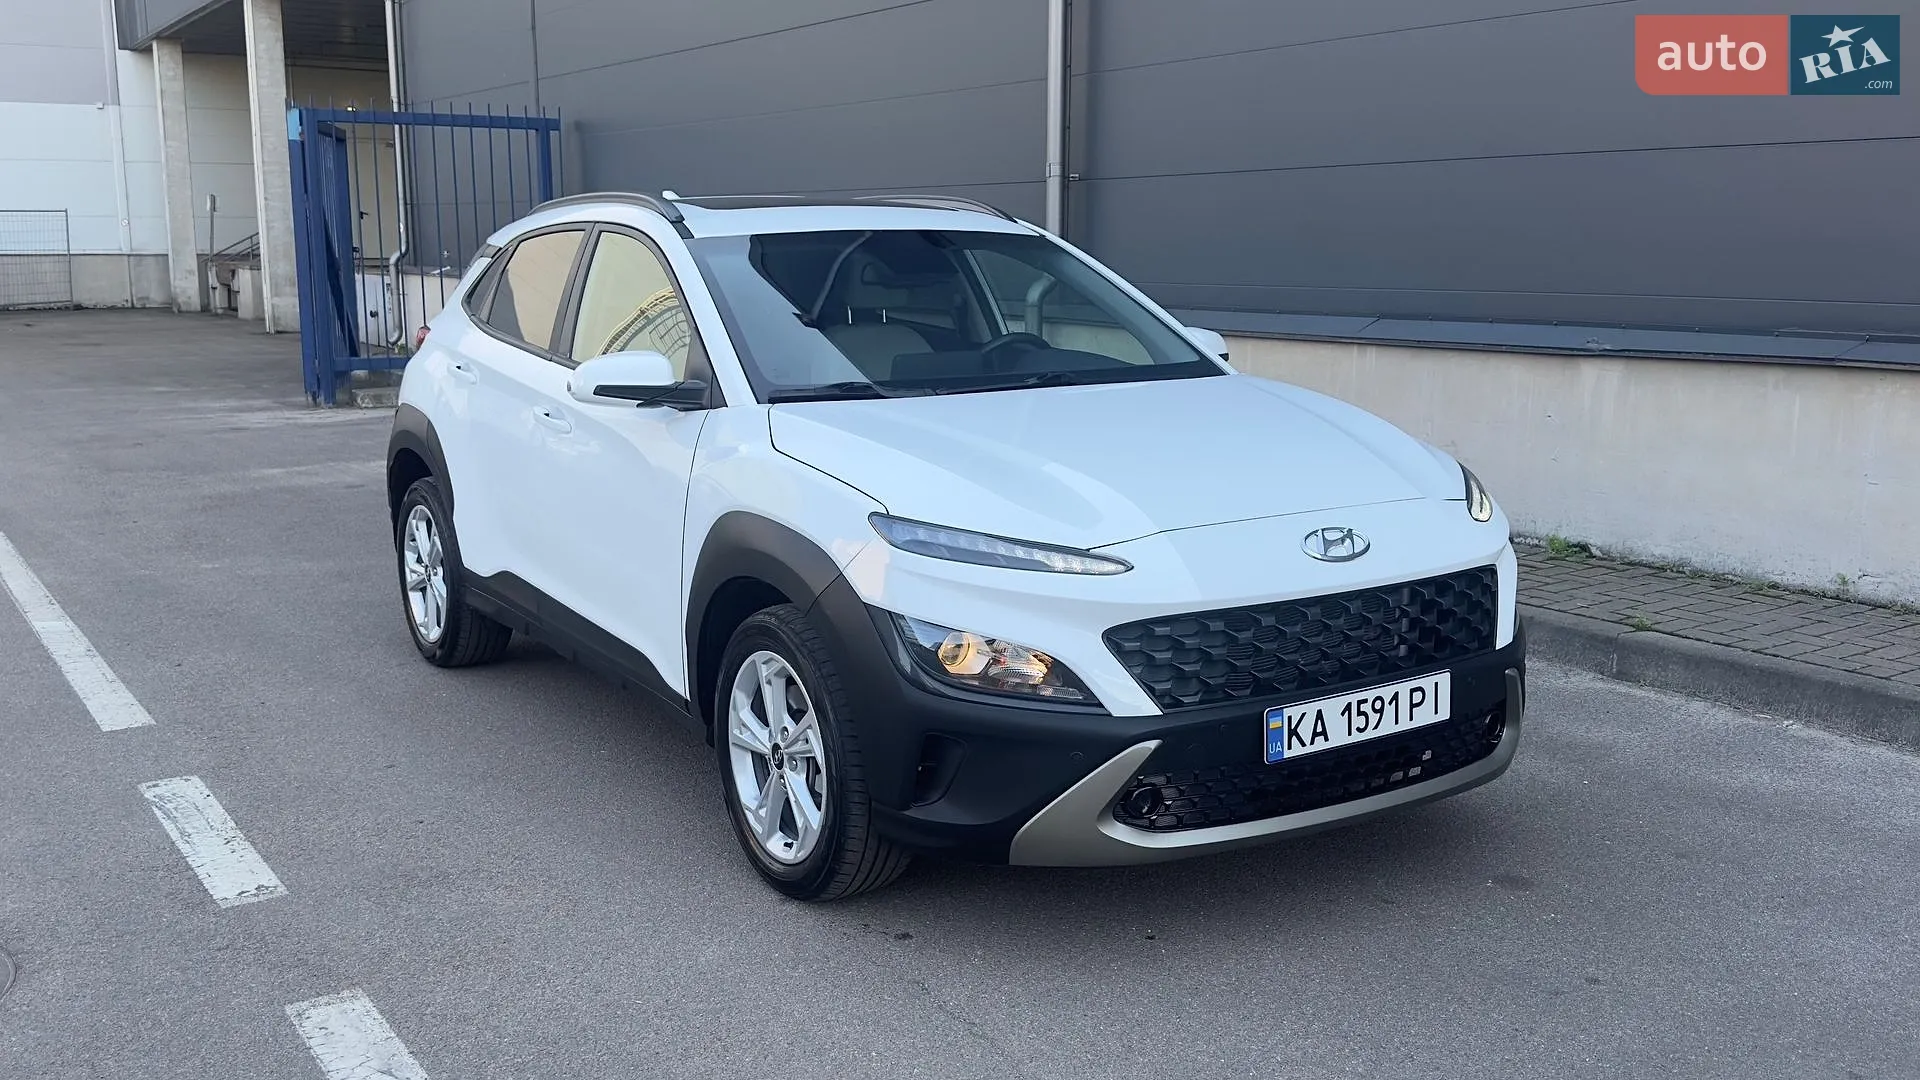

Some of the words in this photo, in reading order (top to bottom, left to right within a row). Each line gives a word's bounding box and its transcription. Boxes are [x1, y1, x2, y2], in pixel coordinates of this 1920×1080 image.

[1287, 708, 1330, 750] KA
[1340, 690, 1400, 737] 1591
[1408, 681, 1439, 723] PI
[1269, 741, 1283, 754] UA
